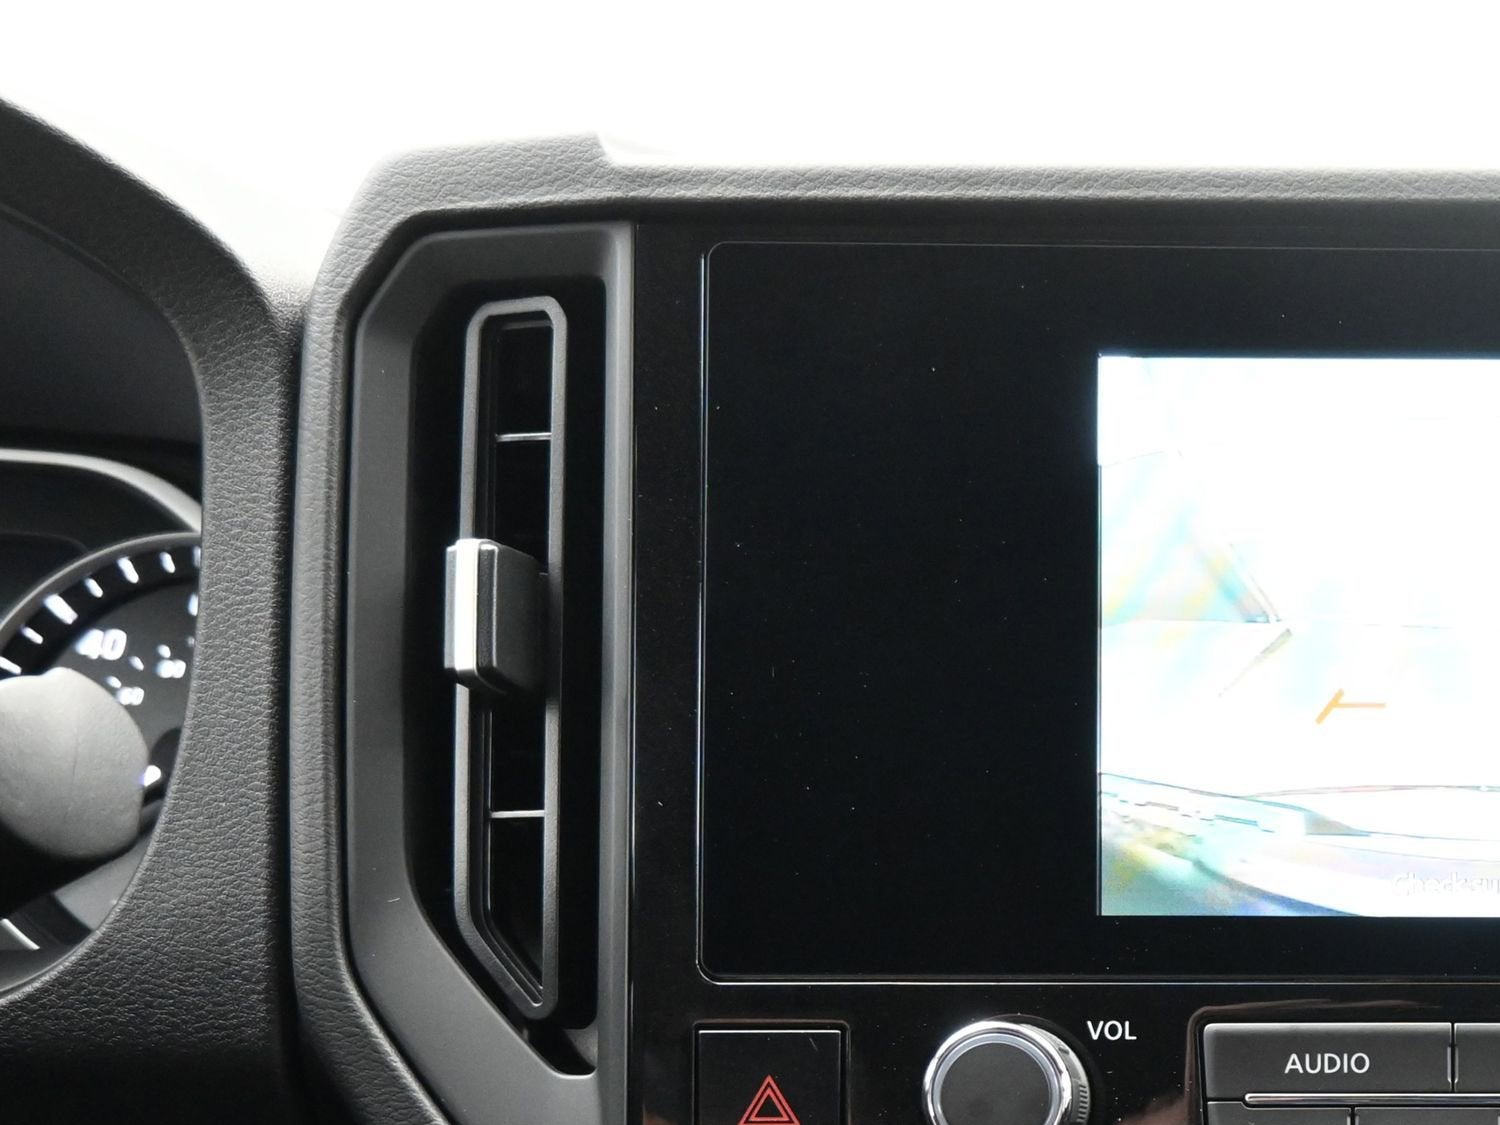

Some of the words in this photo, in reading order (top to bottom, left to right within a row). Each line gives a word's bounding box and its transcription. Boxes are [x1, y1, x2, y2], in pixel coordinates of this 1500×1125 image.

[75, 630, 130, 661] 40
[1087, 1020, 1137, 1040] VOL
[1285, 1053, 1371, 1074] AUDIO
